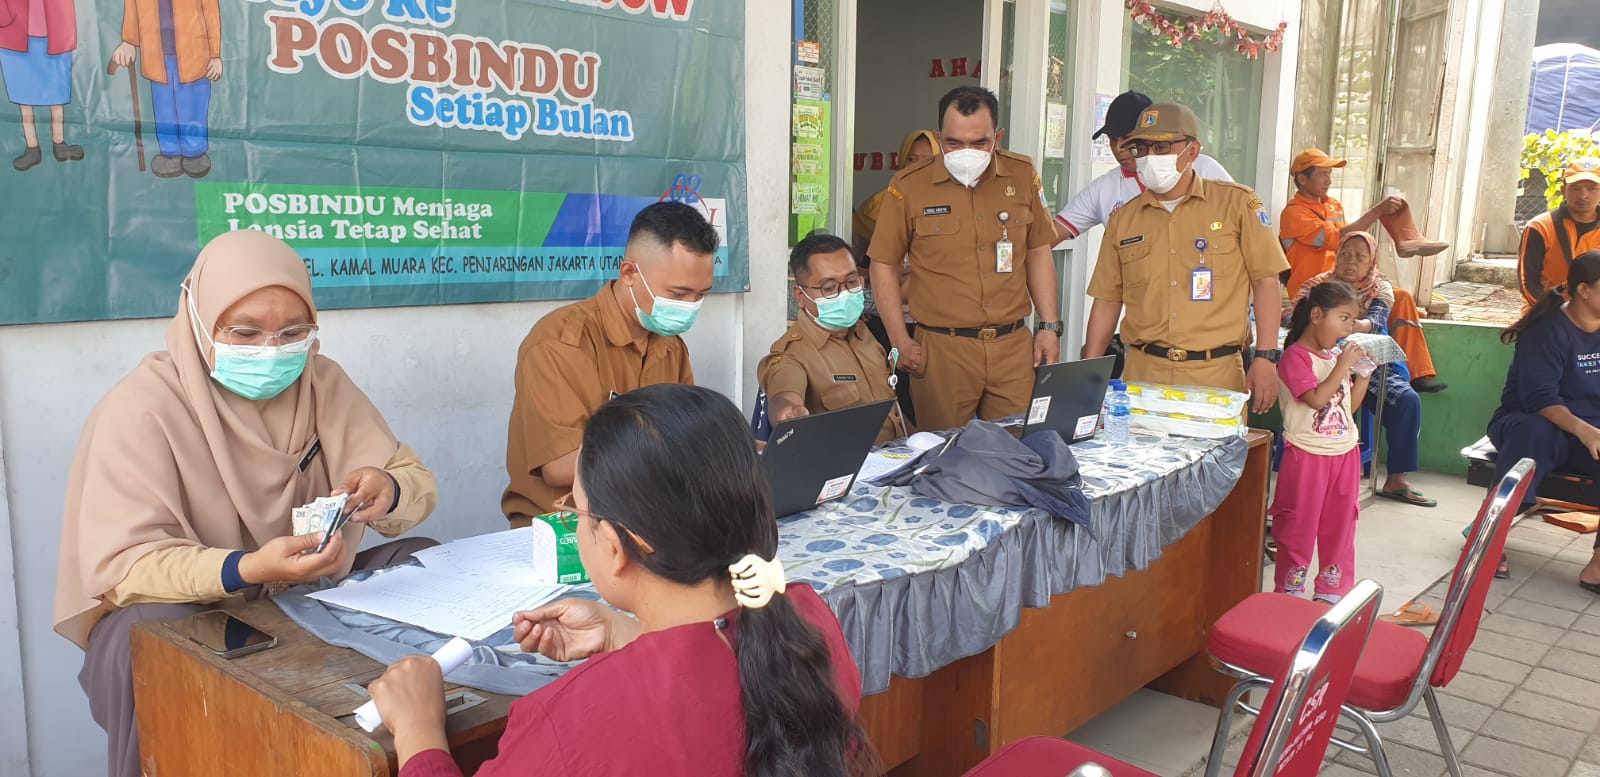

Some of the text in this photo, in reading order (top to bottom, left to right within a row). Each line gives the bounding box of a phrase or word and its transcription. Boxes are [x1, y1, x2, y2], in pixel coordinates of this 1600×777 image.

[269, 15, 598, 98] POSBINDU
[411, 85, 630, 137] Setiap Bulan
[223, 192, 493, 221] POSBINDU Menjaga
[330, 219, 407, 243] Tetap
[412, 221, 483, 240] Sehat
[330, 257, 376, 277] KAMAL
[381, 256, 427, 275] MUARA
[431, 256, 458, 275] KEC.
[463, 255, 545, 273] PENJARINGAN
[549, 255, 596, 272] JAKARTA
